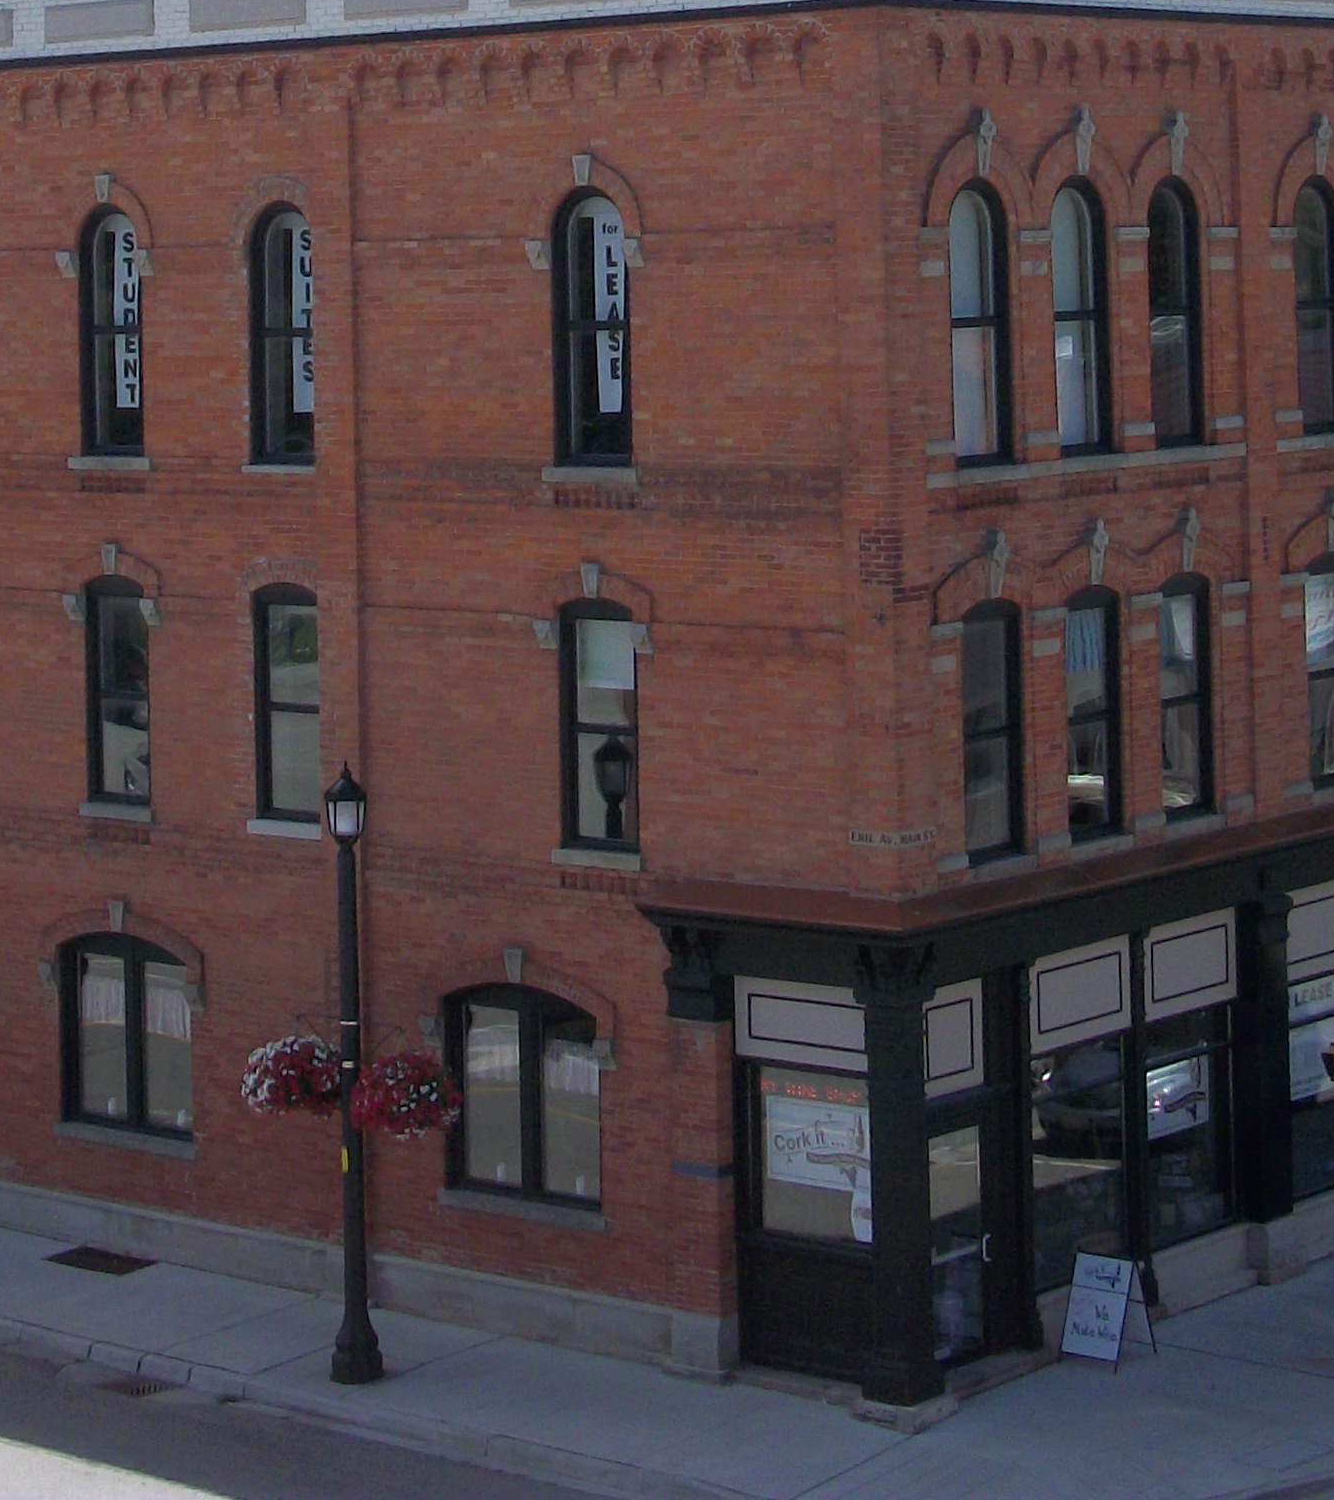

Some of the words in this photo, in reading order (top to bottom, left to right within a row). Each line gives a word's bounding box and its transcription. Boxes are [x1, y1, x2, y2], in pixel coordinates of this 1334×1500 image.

[602, 222, 618, 234] for
[122, 231, 137, 403] STUDENT
[300, 229, 314, 382] SUITES
[605, 245, 620, 380] LEASE
[1294, 982, 1332, 1007] LEASE
[774, 1130, 811, 1151] Cork
